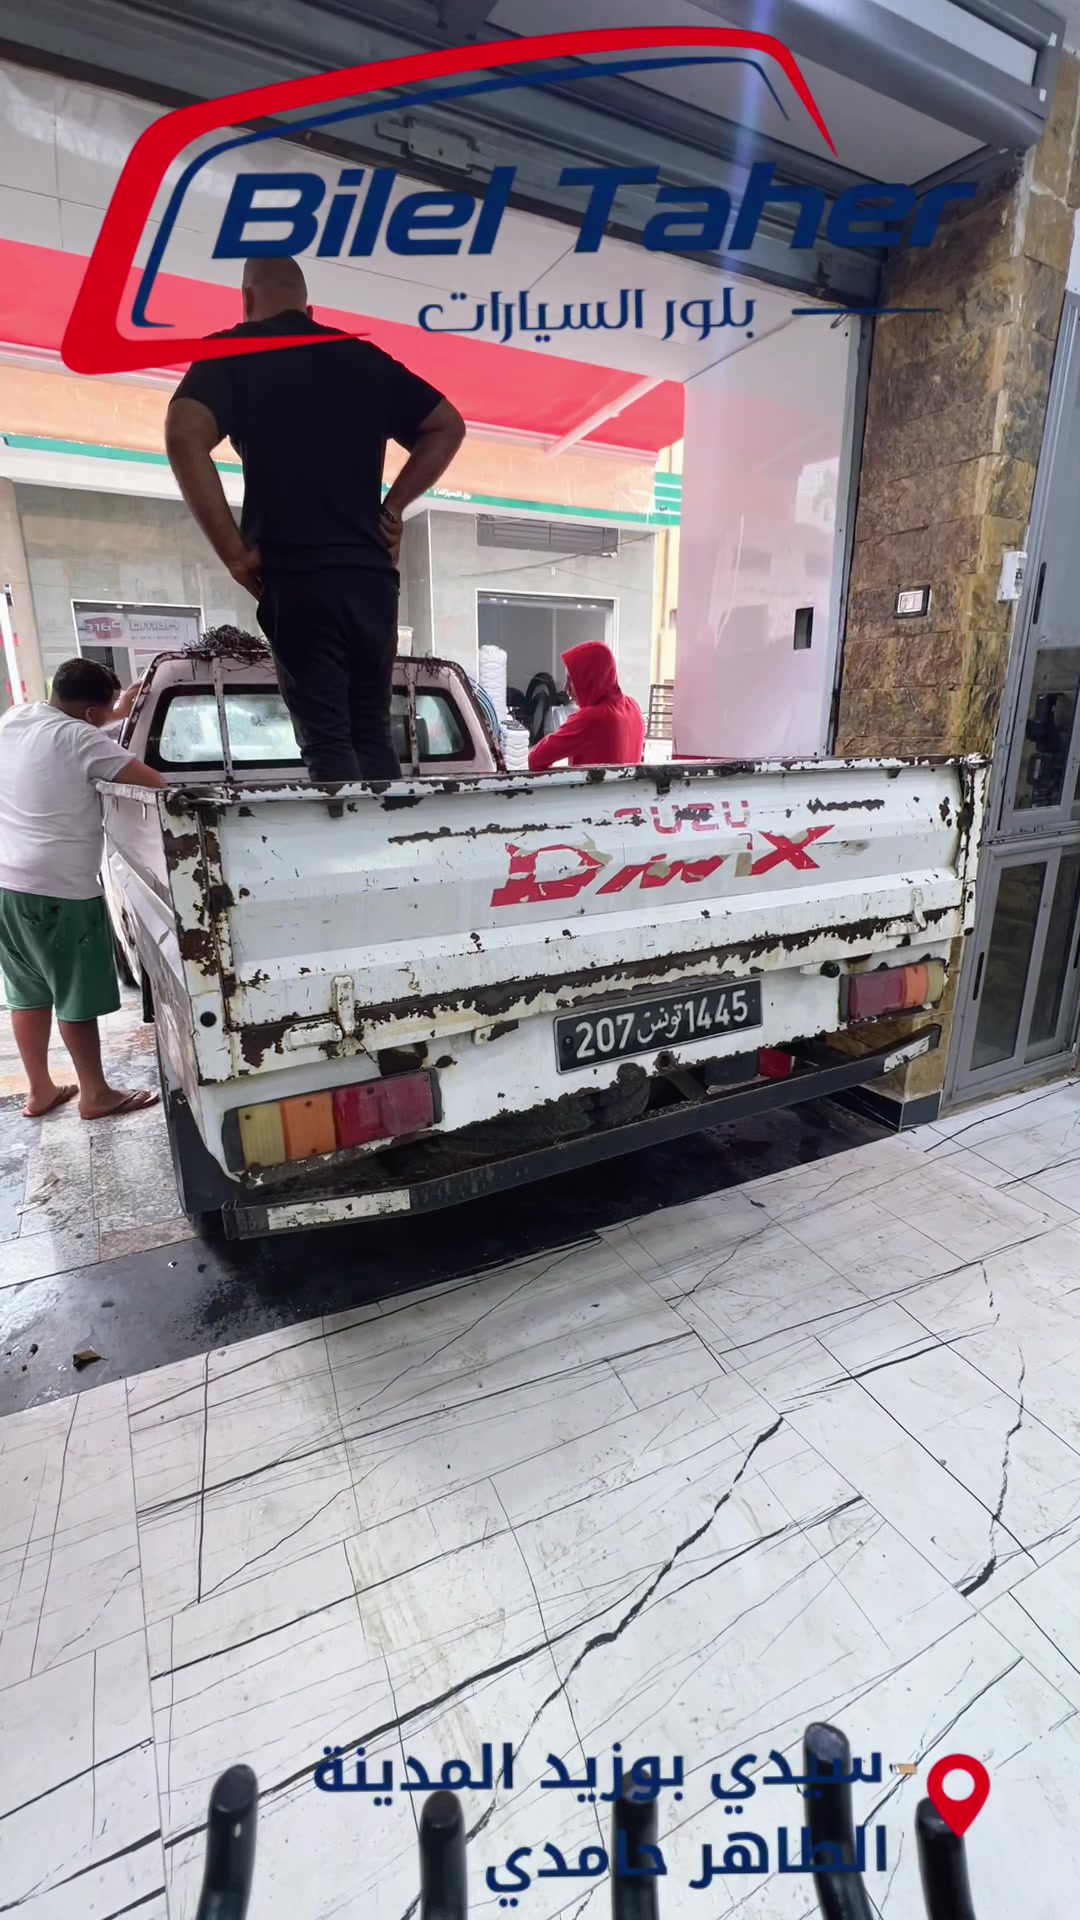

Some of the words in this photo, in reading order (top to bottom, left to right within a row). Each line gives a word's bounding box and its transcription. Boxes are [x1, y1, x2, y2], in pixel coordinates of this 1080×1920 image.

[574, 1012, 636, 1060] 207
[636, 1002, 684, 1045] تونس
[684, 989, 750, 1034] 1445
